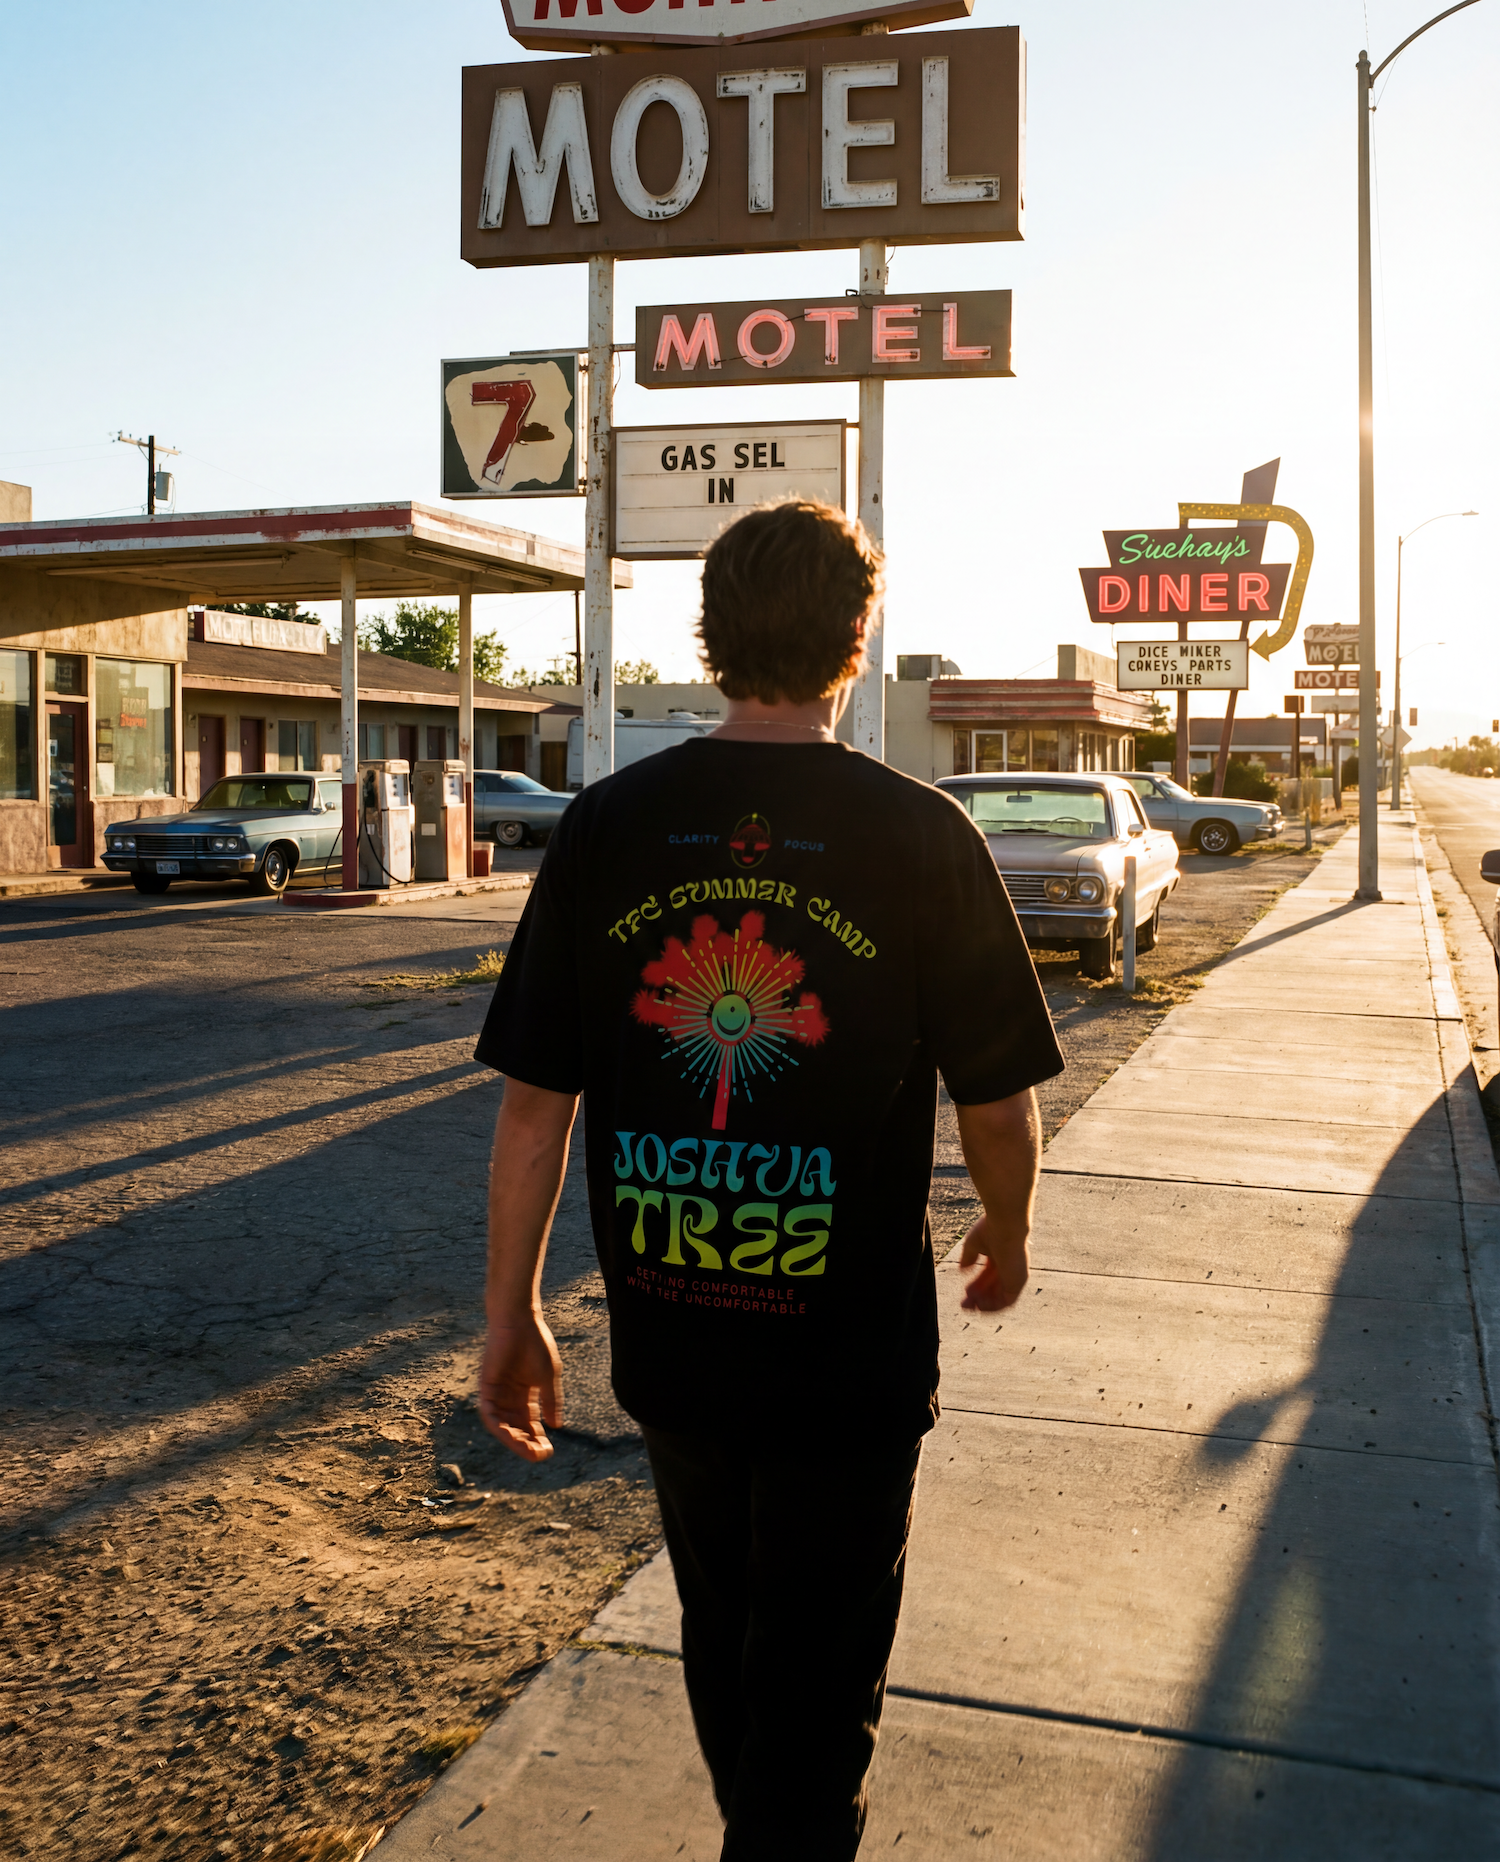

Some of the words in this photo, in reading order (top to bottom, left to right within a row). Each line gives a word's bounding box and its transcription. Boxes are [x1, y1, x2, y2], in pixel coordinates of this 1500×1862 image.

[477, 56, 1000, 229] MOTEL
[653, 302, 992, 371] MOTEL
[470, 380, 537, 485] 7
[661, 444, 716, 471] GAS
[734, 442, 786, 469] SEL
[708, 478, 734, 504] IN
[1099, 573, 1270, 613] DINER
[1138, 646, 1168, 657] DICE
[1189, 660, 1232, 671] PARTS
[1161, 673, 1202, 685] DINER
[1298, 672, 1358, 687] MOTE
[668, 834, 720, 845] CLARITY
[784, 839, 825, 852] FOCUS
[669, 878, 797, 909] SUMMER
[806, 896, 877, 959] CAMP
[614, 1131, 837, 1197] JOSHUA
[615, 1185, 833, 1276] TREE
[685, 1293, 807, 1315] UNCOMFORTABLE
